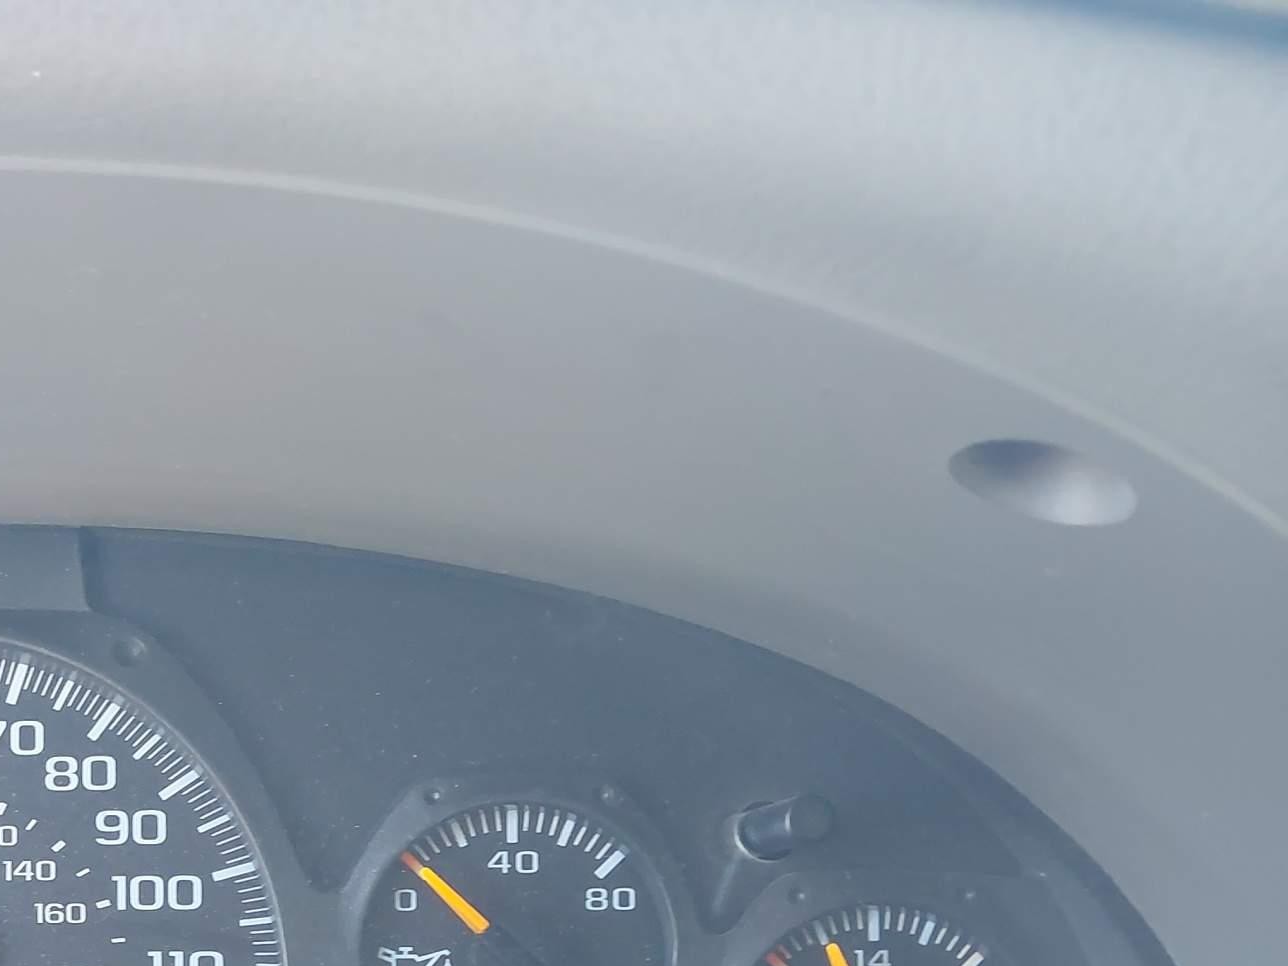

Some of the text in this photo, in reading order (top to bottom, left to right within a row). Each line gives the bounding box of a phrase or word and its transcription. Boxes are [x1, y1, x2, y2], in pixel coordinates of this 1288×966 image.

[45, 757, 118, 792] 80
[95, 811, 167, 846] 90
[2, 860, 57, 883] 140
[487, 851, 541, 875] 40
[112, 876, 203, 911] 100
[394, 889, 418, 913] 0
[584, 887, 637, 911] 80
[35, 903, 87, 926] 160
